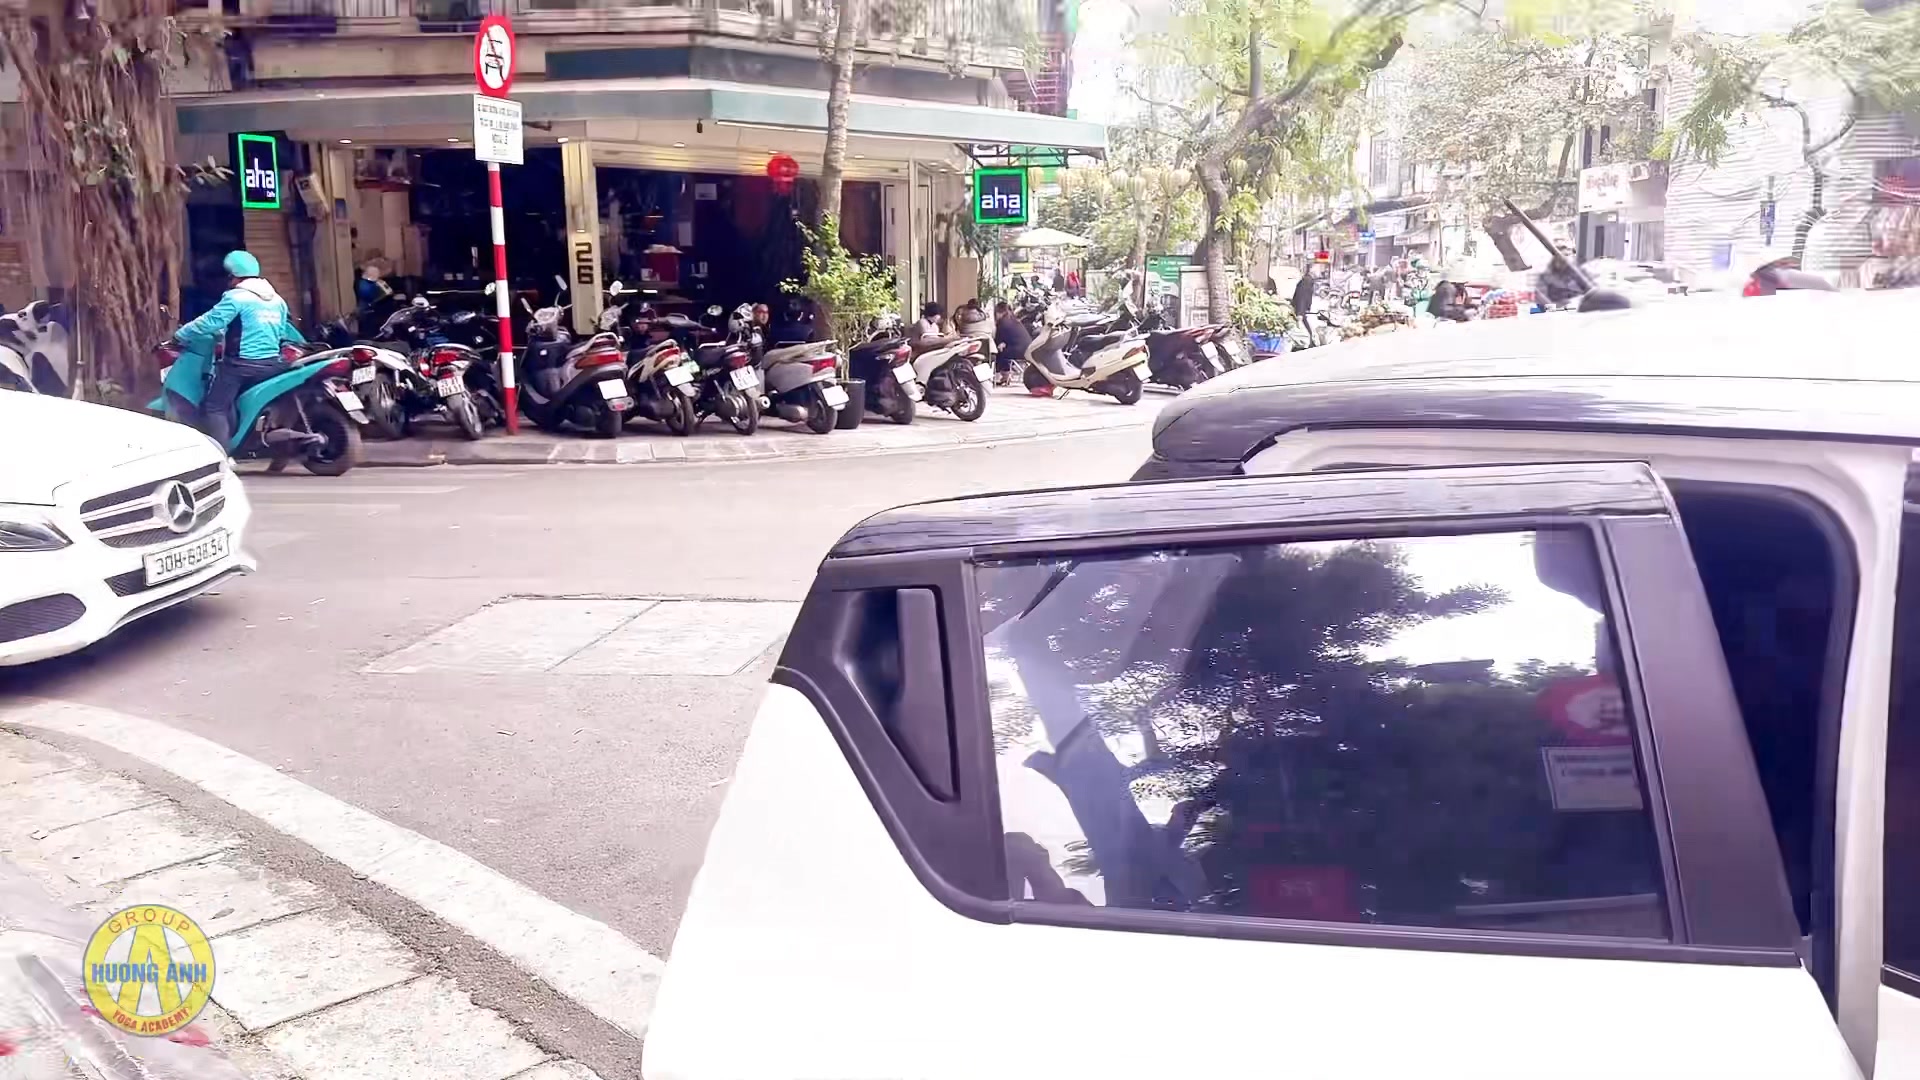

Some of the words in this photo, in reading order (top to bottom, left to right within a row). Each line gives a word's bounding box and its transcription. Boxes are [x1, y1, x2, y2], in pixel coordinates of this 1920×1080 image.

[245, 157, 275, 189] aha
[981, 186, 1021, 209] aha
[575, 242, 594, 284] 26
